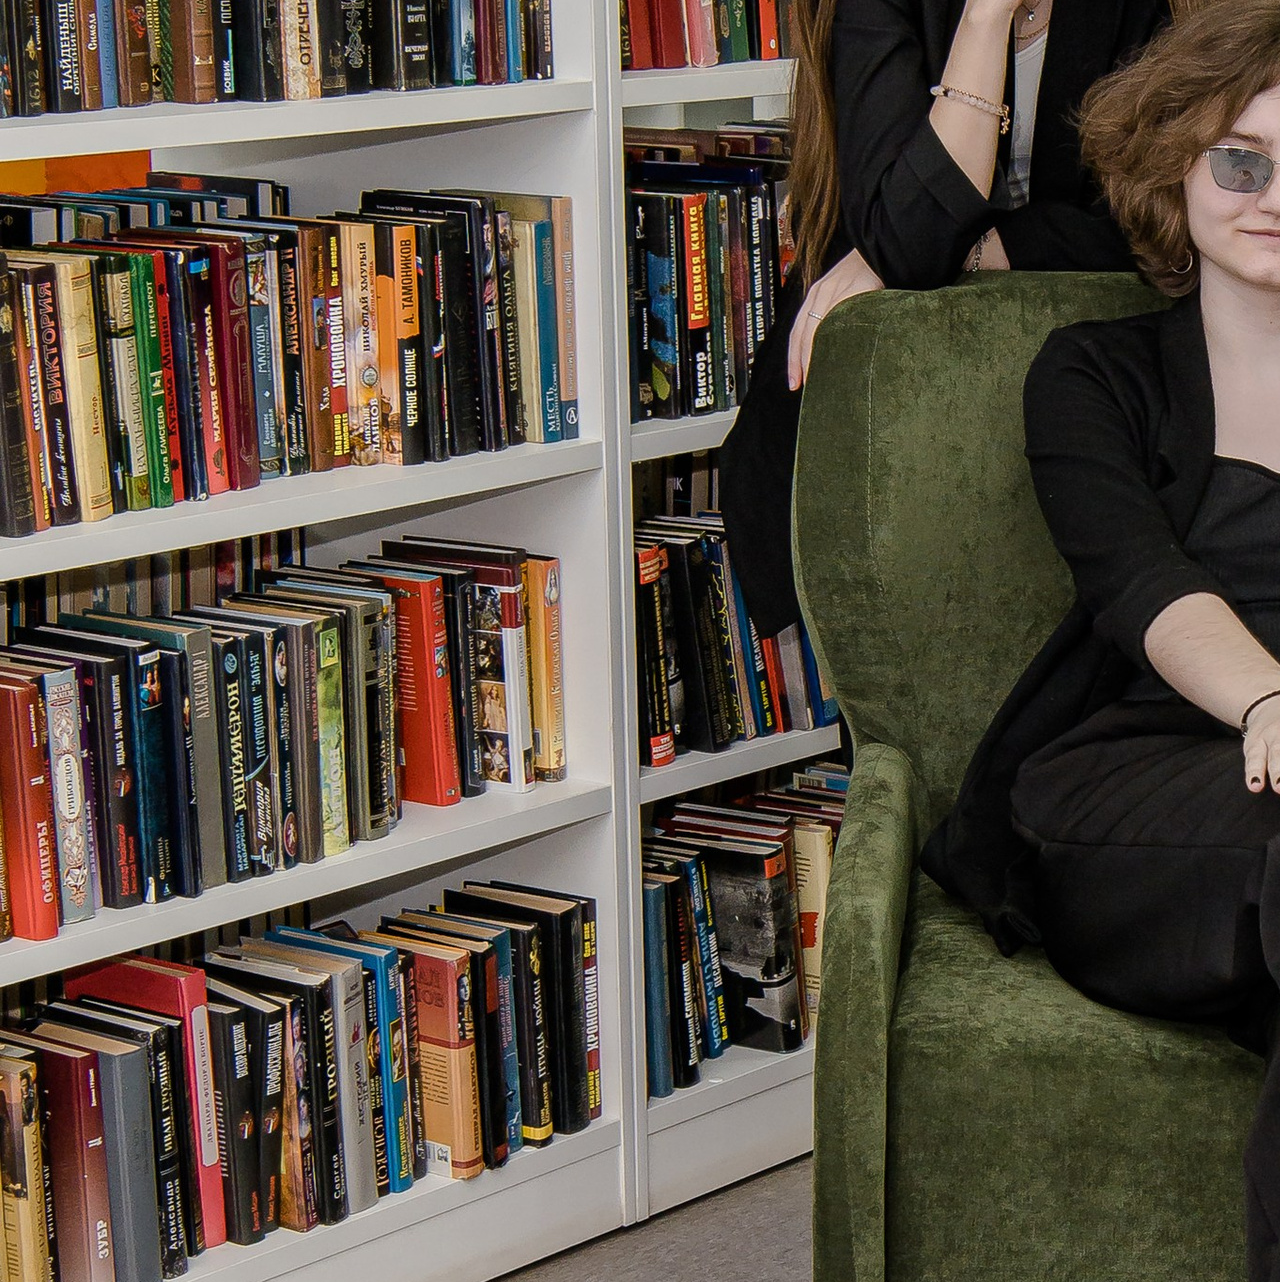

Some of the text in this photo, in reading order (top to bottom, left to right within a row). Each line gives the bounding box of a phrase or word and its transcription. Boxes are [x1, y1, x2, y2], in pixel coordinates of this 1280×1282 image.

[55, 1, 74, 91] НАЙДЕНЫШ
[69, 34, 81, 95] ОБРЕТЕНИЕ
[222, 60, 232, 94] БОЕВИК
[27, 68, 42, 108] 1612
[688, 205, 700, 251] книга
[355, 241, 371, 352] НИКОЛАЙ ХМУРЫЙ
[400, 238, 415, 325] А. ТАМОНИКОВ
[691, 256, 705, 321] Главная
[750, 195, 765, 342] ВТОРАЯ ПОПЫТКА КОЛЧАКА
[145, 281, 157, 337] ПЕРЕВОРОТ
[280, 248, 301, 356] АЛЕКСАНДР II
[503, 270, 518, 392] КНЯГИНЯ ОЛЬГА
[37, 281, 64, 405] ВИКТОРИЯ
[126, 336, 141, 378] ЗАРИ
[204, 304, 222, 443] МАРИЯ СЕМЁНОВА
[254, 323, 268, 374] МАЛУША
[325, 296, 347, 389] ХРОНОВОЙНА
[319, 386, 331, 411] Хэда
[403, 348, 419, 428] ЧЕРНОЕ СОЛНЦЕ
[544, 388, 558, 433] МЕСТЬ
[694, 351, 708, 409] Виктор
[156, 404, 171, 484] Ольга ЕЛИСЕЕВА
[332, 414, 344, 457] Владимир
[369, 397, 381, 453] ЛАНЦОВ
[191, 658, 211, 719] АЛЕКСАНДР
[253, 693, 268, 759] псевдоним
[64, 756, 76, 815] ГРИБОЕДОВ
[255, 779, 268, 841] Виктория
[263, 786, 274, 838] Дьякова
[36, 820, 55, 904] ОФИЦЕРЫ
[707, 931, 724, 988] ДЕСАНТНИК
[532, 978, 547, 1079] ПТИЦА ВОЙНЫ
[582, 964, 600, 1052] ХРОНОВОЙНА
[232, 1022, 249, 1080] ВОЗВРАЩЕНИЕ
[265, 1020, 283, 1097] ПРОФЕССИОНАЛЫ
[319, 1007, 339, 1101] ГРОЗНЫЙ
[156, 1050, 174, 1152] ИВАН ГРОЗНЫЙ
[354, 1060, 365, 1126] ЖЕСТОКИЙ
[95, 1219, 109, 1259] ЗУБР
[165, 1180, 180, 1251] Александр
